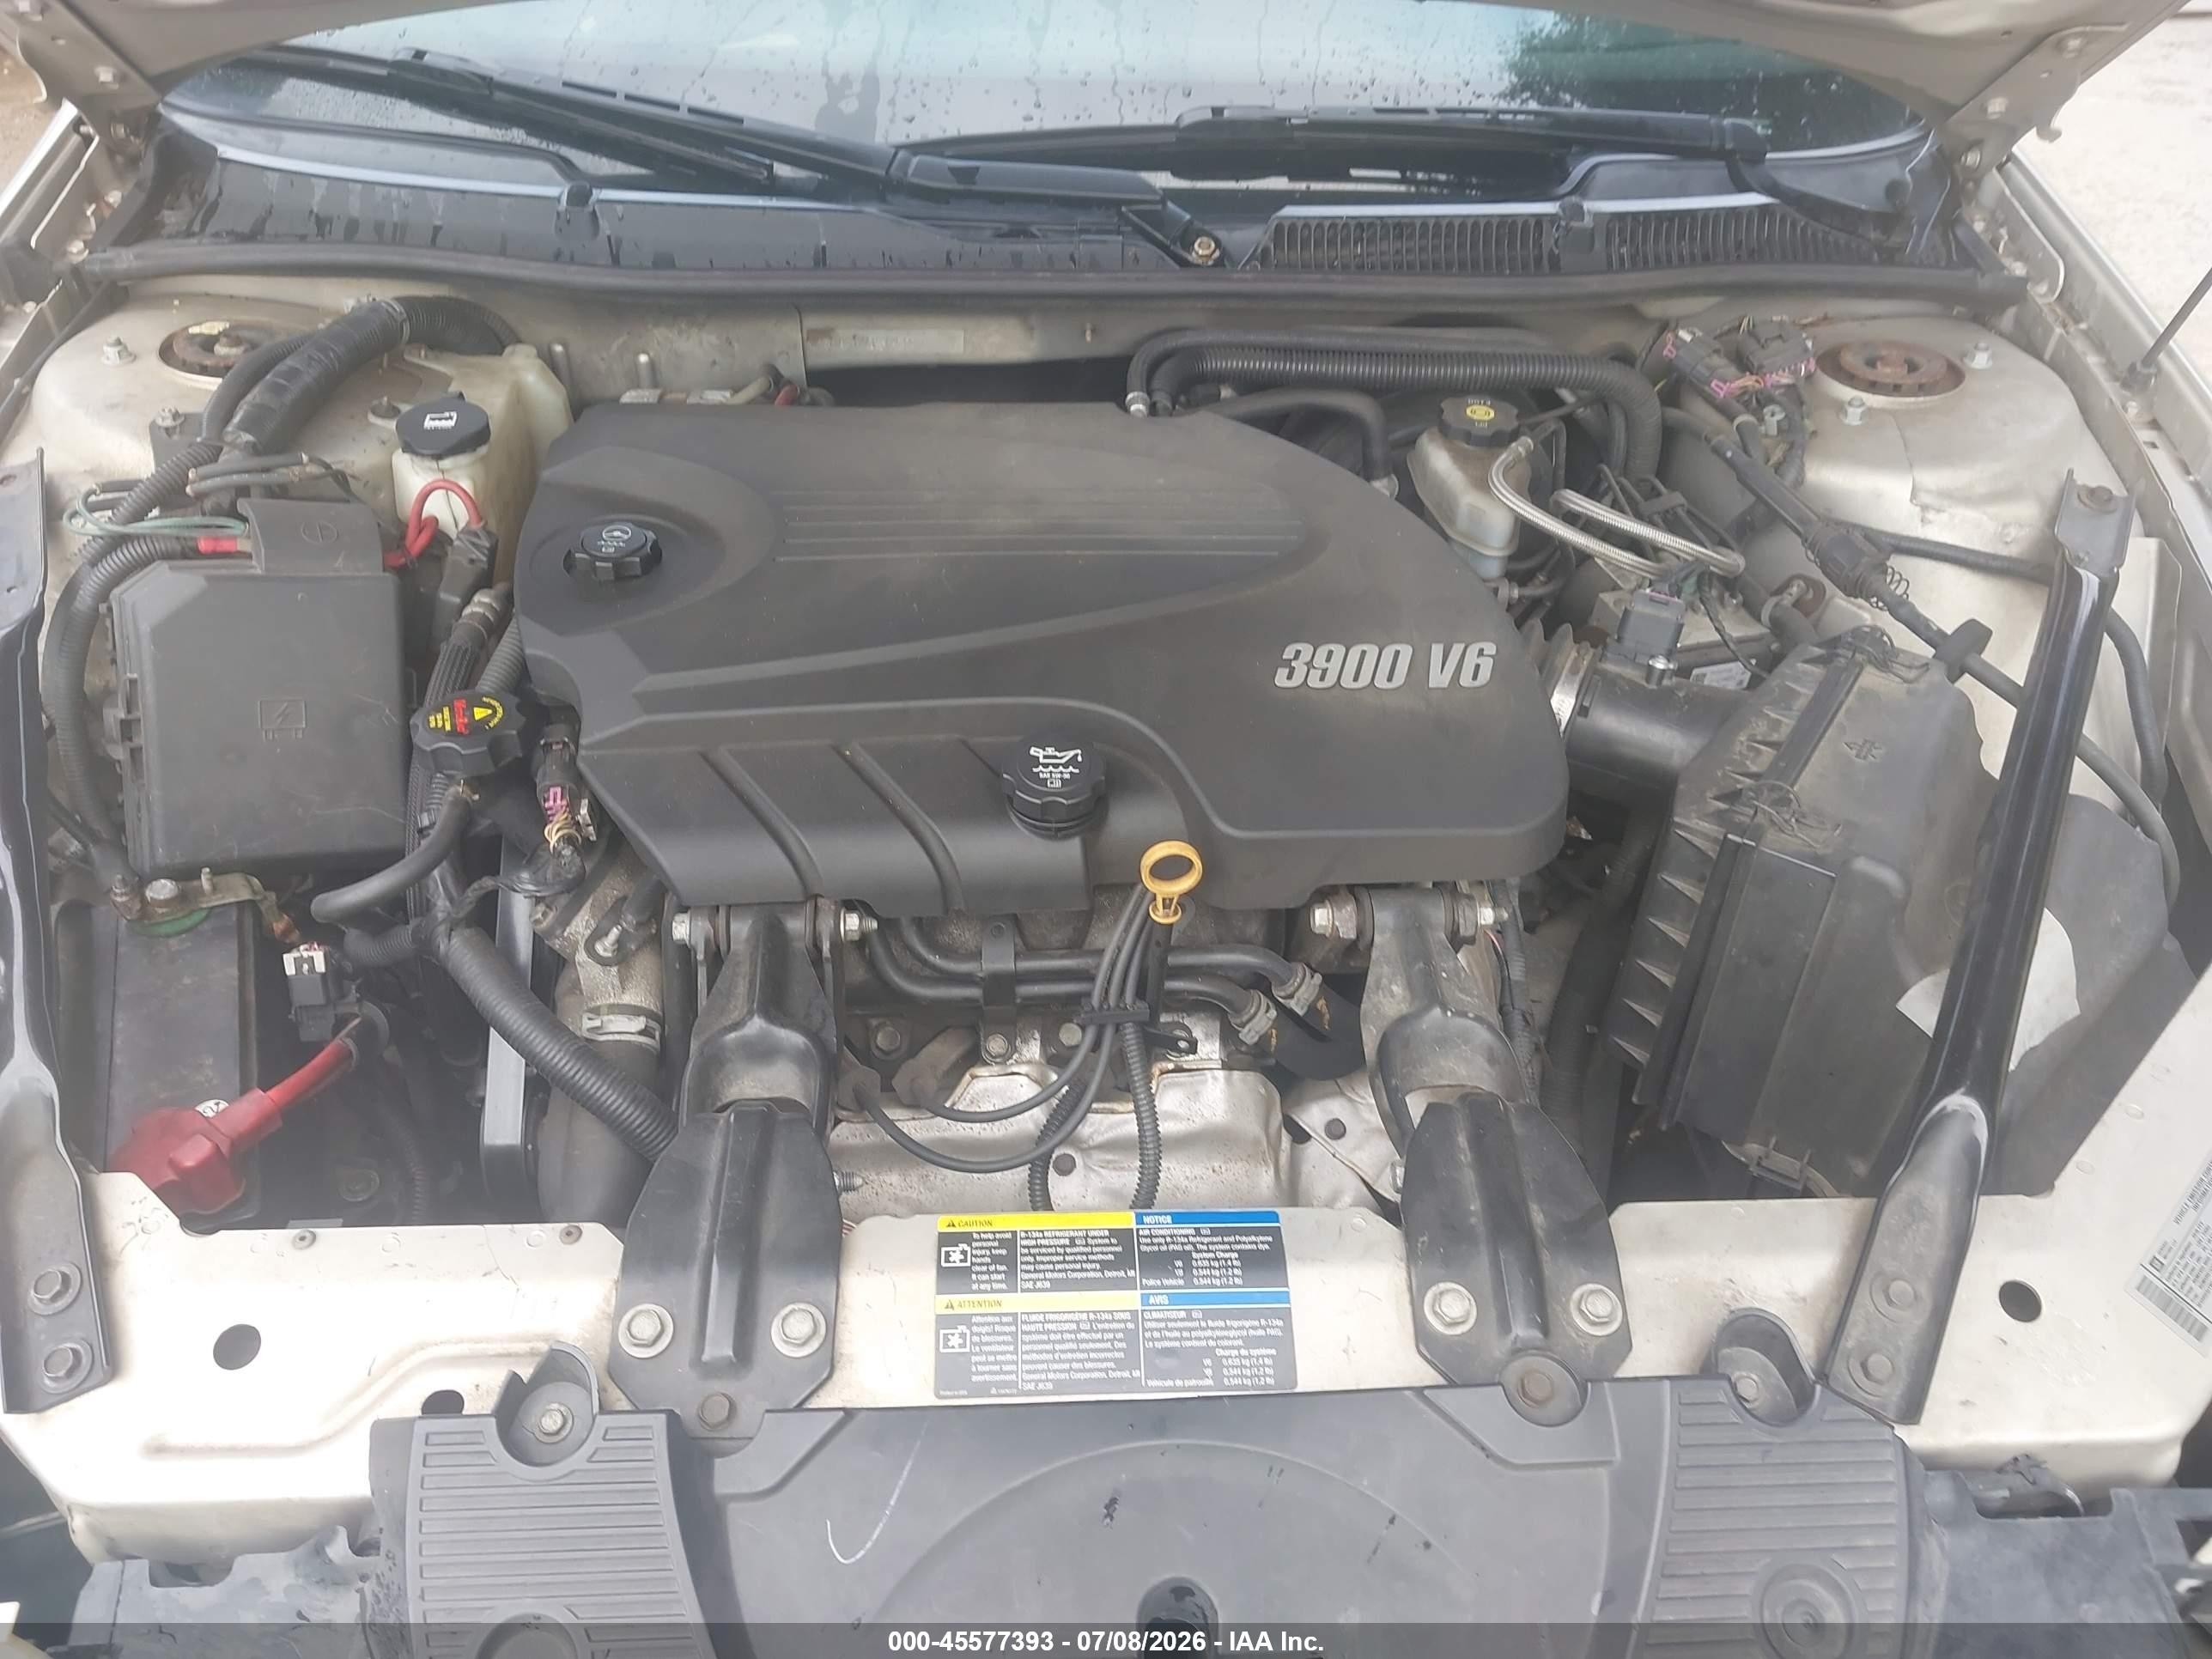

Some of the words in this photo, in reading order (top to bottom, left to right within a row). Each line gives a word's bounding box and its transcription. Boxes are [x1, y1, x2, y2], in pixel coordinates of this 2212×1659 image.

[1273, 641, 1413, 690] 3900
[1429, 641, 1497, 689] V6
[957, 1300, 1002, 1309] ATTENTION
[1149, 1295, 1169, 1305] AVIS
